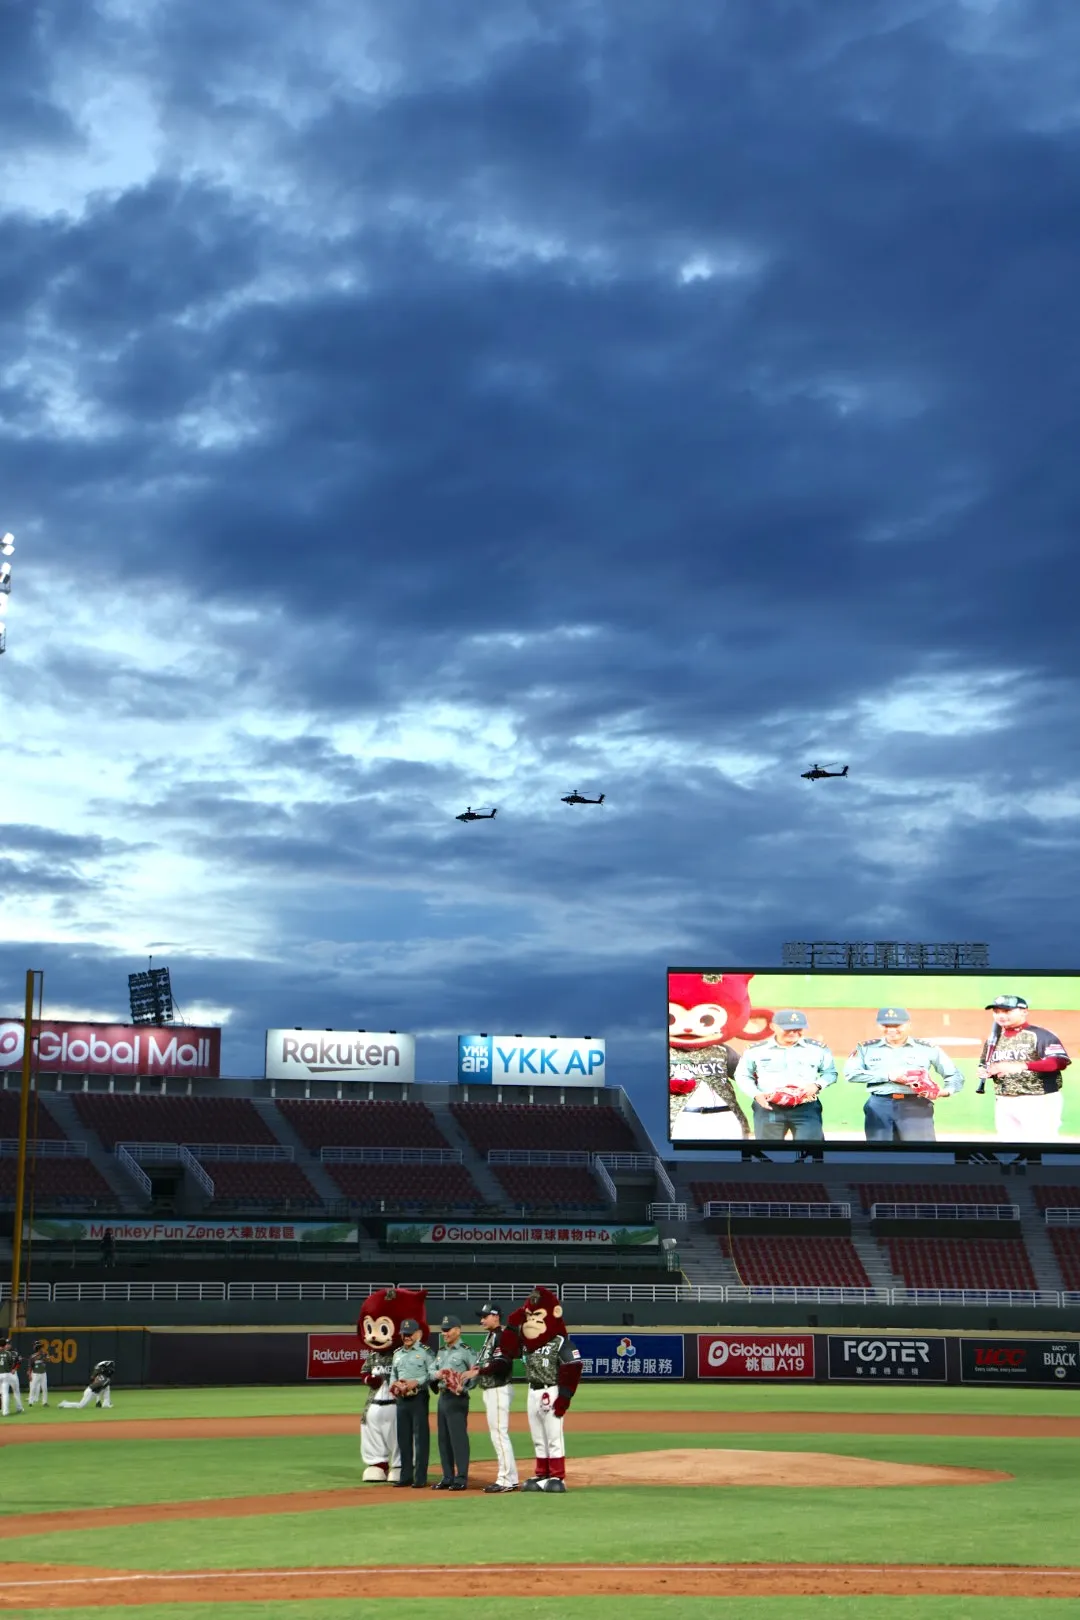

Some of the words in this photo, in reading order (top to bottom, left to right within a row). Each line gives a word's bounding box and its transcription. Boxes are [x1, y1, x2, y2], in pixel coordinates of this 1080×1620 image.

[33, 1031, 140, 1064] Global
[148, 1036, 210, 1067] Mall
[282, 1037, 400, 1066] Rakuten
[462, 1045, 489, 1056] YKK
[496, 1047, 560, 1074] YKK
[564, 1049, 605, 1075] AP
[153, 1225, 184, 1239] Fun
[186, 1225, 225, 1239] Zone
[447, 1227, 497, 1240] Global
[499, 1228, 529, 1241] Mall
[531, 1228, 610, 1241] 環球購物中心
[313, 1349, 358, 1360] Rakuten
[729, 1343, 774, 1357] Global
[776, 1343, 804, 1357] Mall
[844, 1341, 930, 1362] FOOTER
[973, 1348, 1026, 1365] UCC
[581, 1358, 673, 1374] 雷門數據服務
[1043, 1353, 1077, 1366] BLACK
